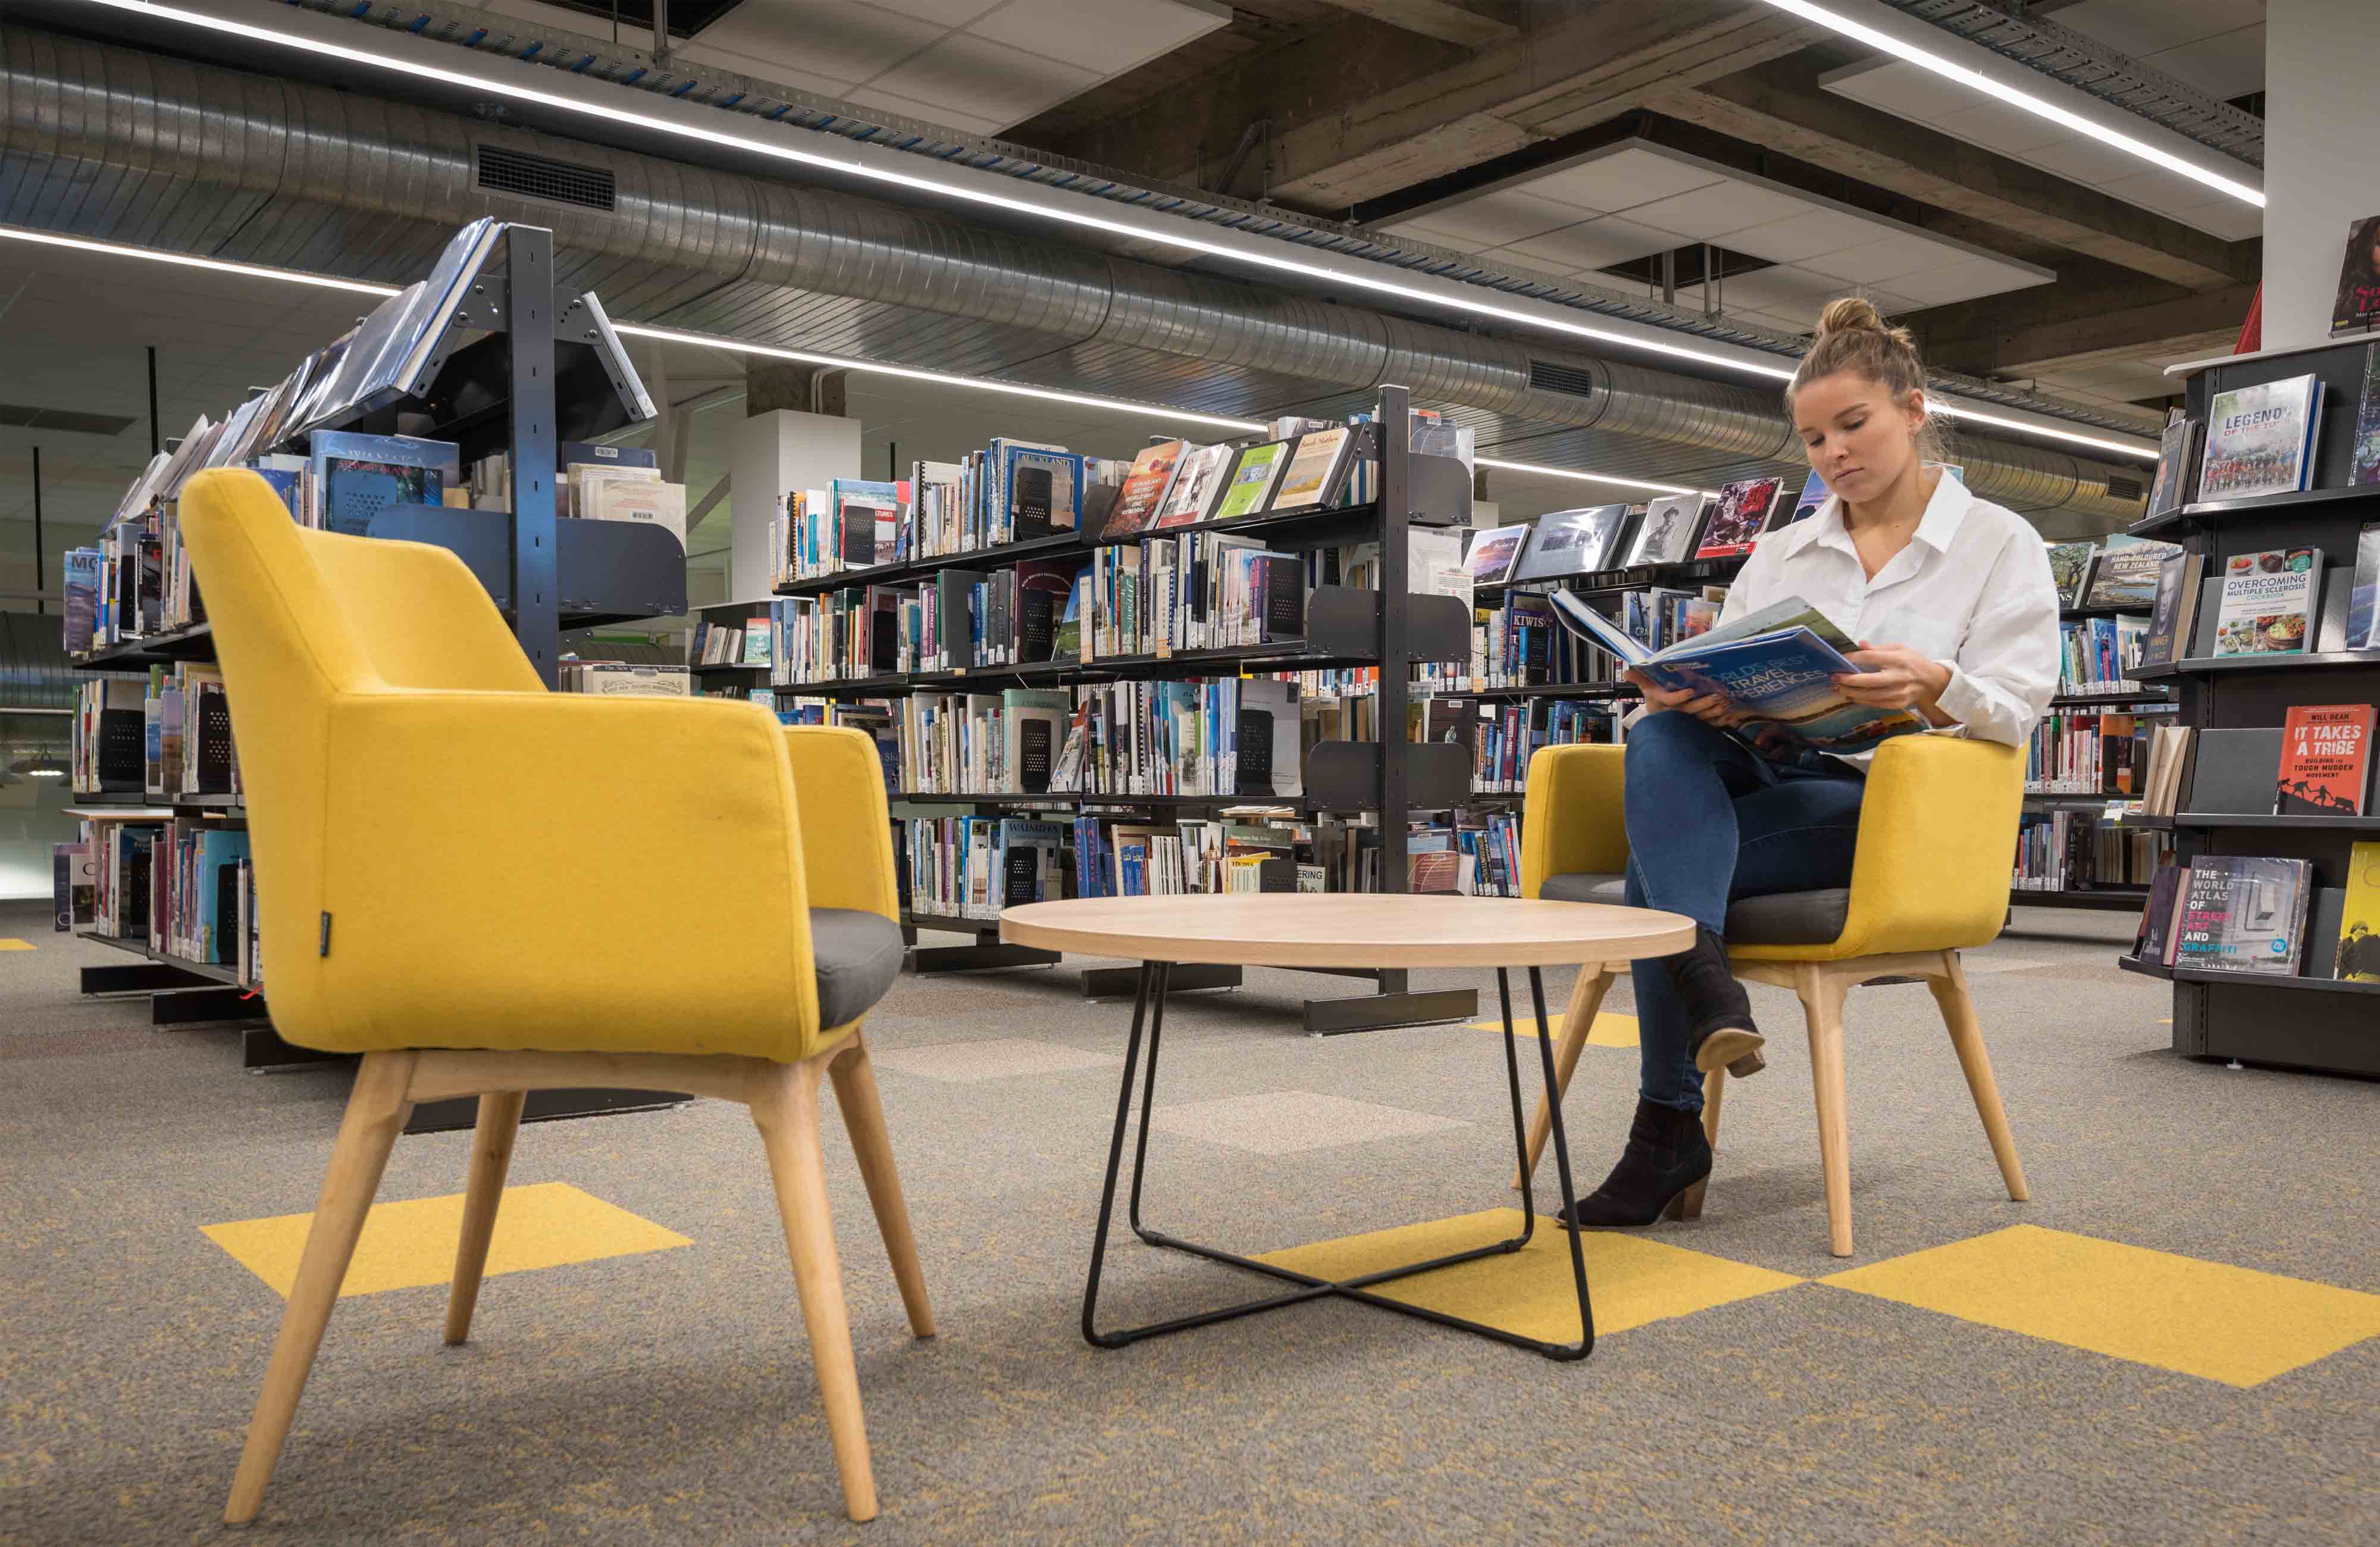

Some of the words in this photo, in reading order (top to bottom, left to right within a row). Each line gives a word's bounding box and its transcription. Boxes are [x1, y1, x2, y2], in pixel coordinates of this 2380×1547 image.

[1021, 454, 1070, 466] AUCKLAND
[2228, 574, 2306, 590] OVERCOMING
[2227, 588, 2263, 597] MULTIPLE
[2265, 583, 2306, 594] SCLEROSIS
[1514, 615, 1544, 628] KIWIS
[1767, 655, 1809, 668] BEST
[1728, 667, 1793, 690] TRAVEL
[1730, 669, 1828, 698] PERIENCES
[2294, 726, 2309, 741] IT
[2313, 725, 2362, 740] TAKES
[2296, 741, 2309, 756] A
[2313, 740, 2356, 756] TRIBE
[2194, 869, 2218, 879] THE
[2193, 880, 2234, 890] WORLD
[2191, 891, 2229, 901] ATLAS
[2190, 900, 2205, 910] OF
[2188, 911, 2232, 923] STREET
[2186, 922, 2209, 932] ART
[2184, 931, 2209, 941] AND
[2183, 942, 2238, 954] GRAFFITI
